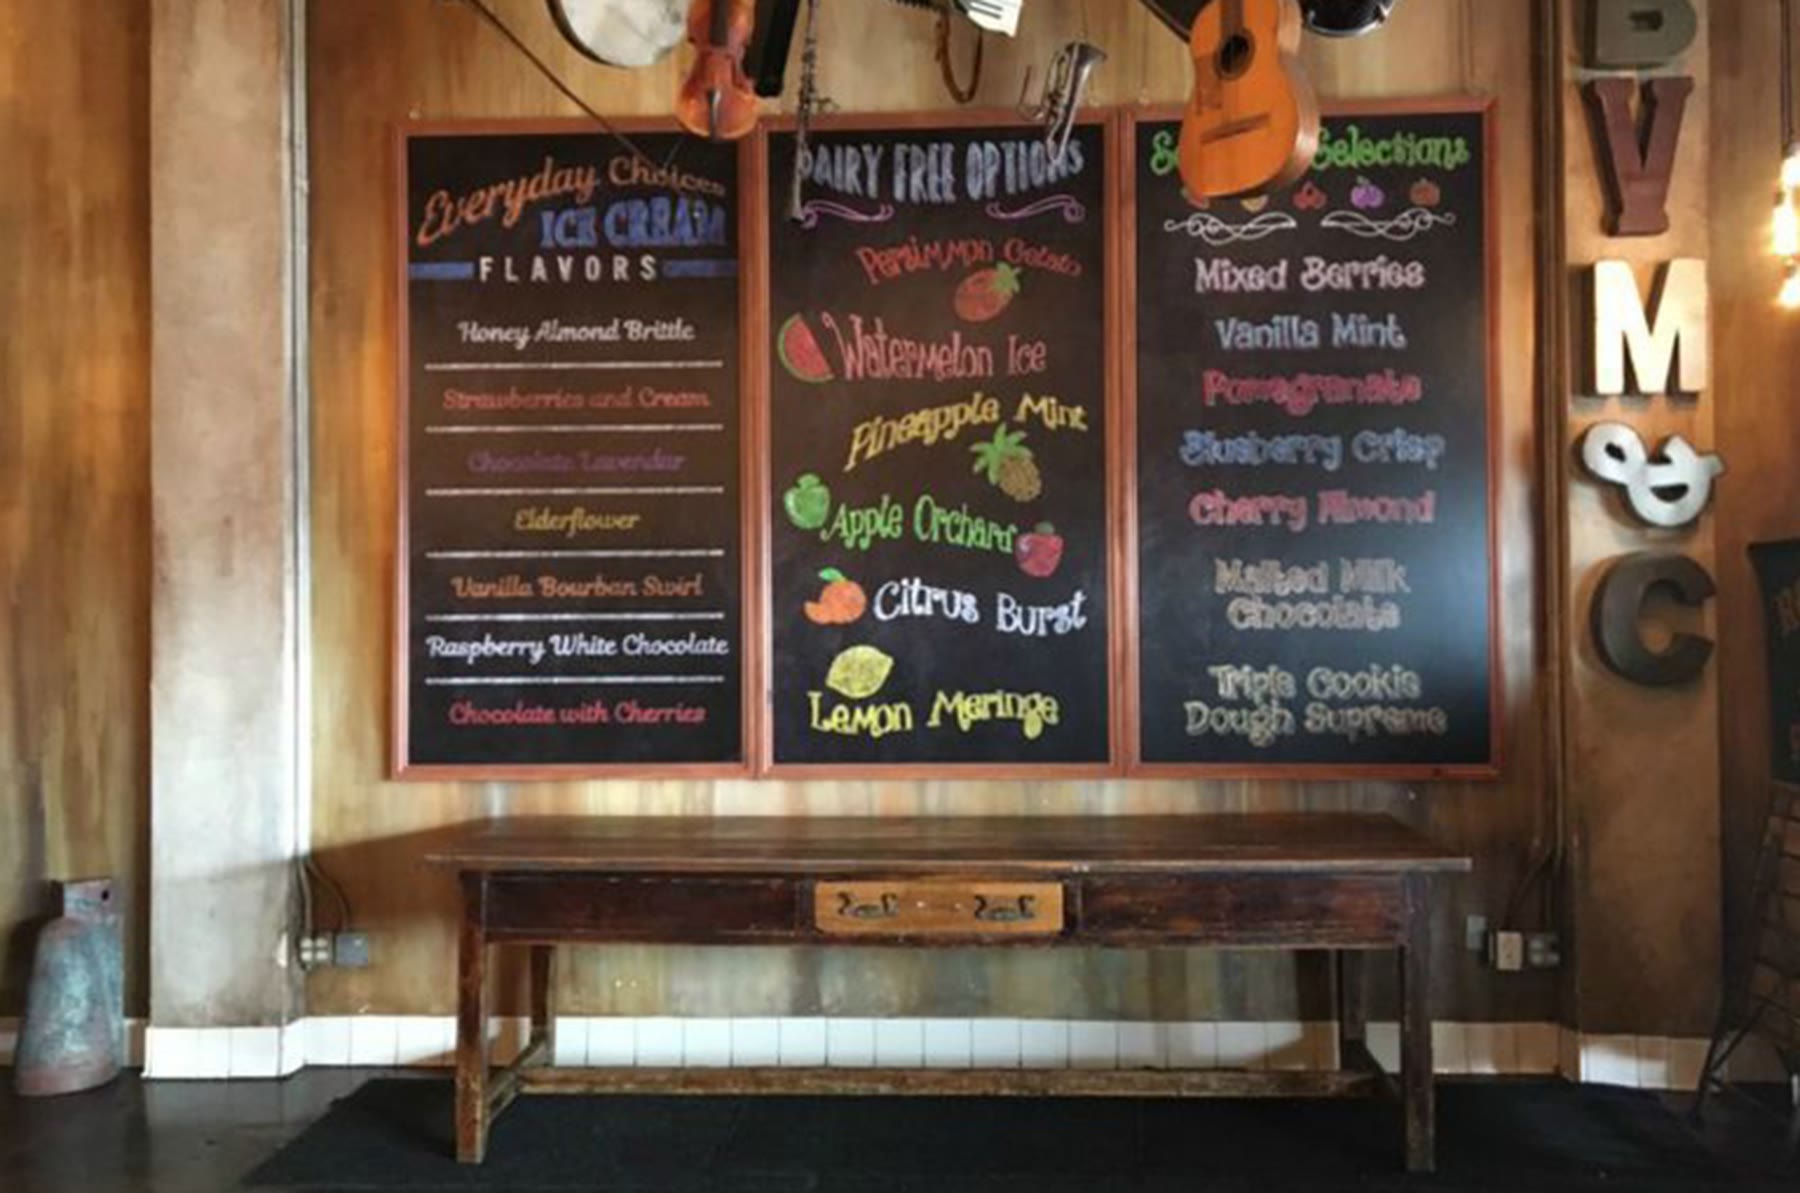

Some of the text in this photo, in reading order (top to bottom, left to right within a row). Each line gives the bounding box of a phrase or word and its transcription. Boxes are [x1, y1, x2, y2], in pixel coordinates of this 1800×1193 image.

[893, 142, 956, 203] FREE
[417, 155, 726, 245] Everyday Choices
[540, 196, 727, 248] ICE CREAM
[479, 255, 657, 282] FLAVORS
[1195, 254, 1426, 293] Mixed Berries
[458, 317, 696, 349] Honey Almond Brittle
[821, 311, 1047, 381] Watermelon Ice
[1215, 312, 1408, 349] Vanilla Mint
[443, 385, 710, 409] Strawberries and Cream
[1203, 368, 1422, 416] Pomegranate
[843, 391, 1088, 472] Pineapple Mint
[1179, 427, 1446, 471] Blueberry Crisp
[467, 452, 573, 473] Chocolate
[515, 507, 640, 537] Elderflower
[821, 495, 1017, 554] Apple Orchard
[1189, 487, 1436, 532] Cherry Almond
[452, 574, 532, 598] Vanilla
[642, 573, 704, 597] Swirl
[1214, 556, 1411, 596] Malted Milk
[873, 577, 1088, 637] Citrus Burst
[1226, 594, 1401, 632] Chocolate
[425, 632, 729, 665] Raspberry White Chocolate
[1208, 663, 1422, 704] Triple Cookie
[449, 699, 705, 724] Chocolate with Cherries
[807, 689, 1060, 740] Lemon Meringe
[1184, 701, 1448, 747] Dough Supreme
